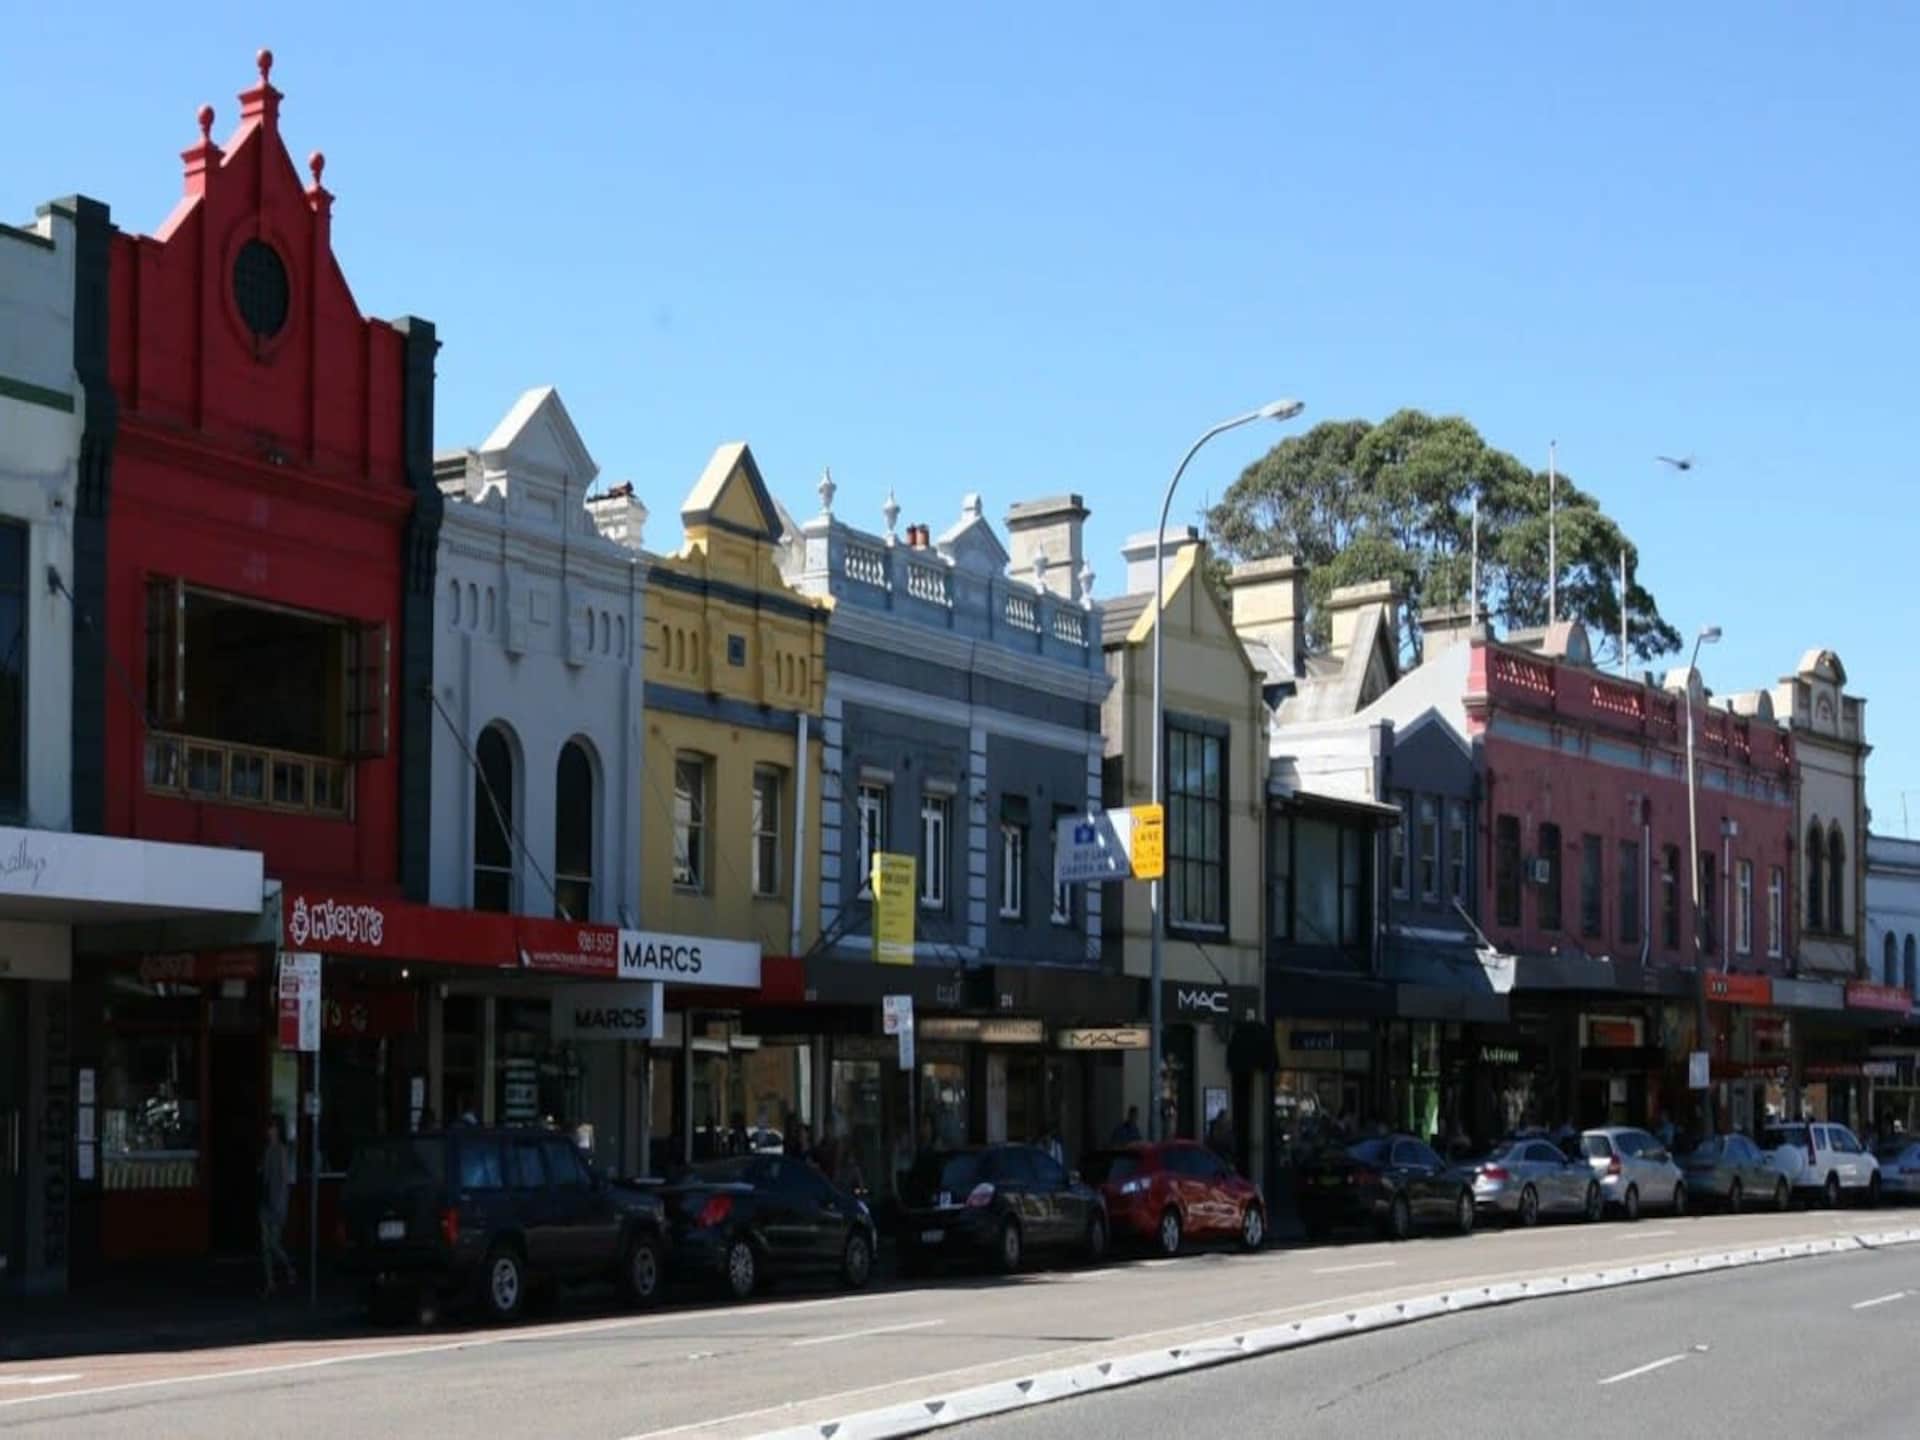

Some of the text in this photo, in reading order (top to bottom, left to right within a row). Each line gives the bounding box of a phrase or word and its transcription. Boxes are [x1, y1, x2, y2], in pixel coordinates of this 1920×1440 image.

[623, 941, 702, 974] MARCS
[1177, 989, 1229, 1013] MAC
[575, 1008, 646, 1028] MARCS
[1070, 1030, 1137, 1046] MAC
